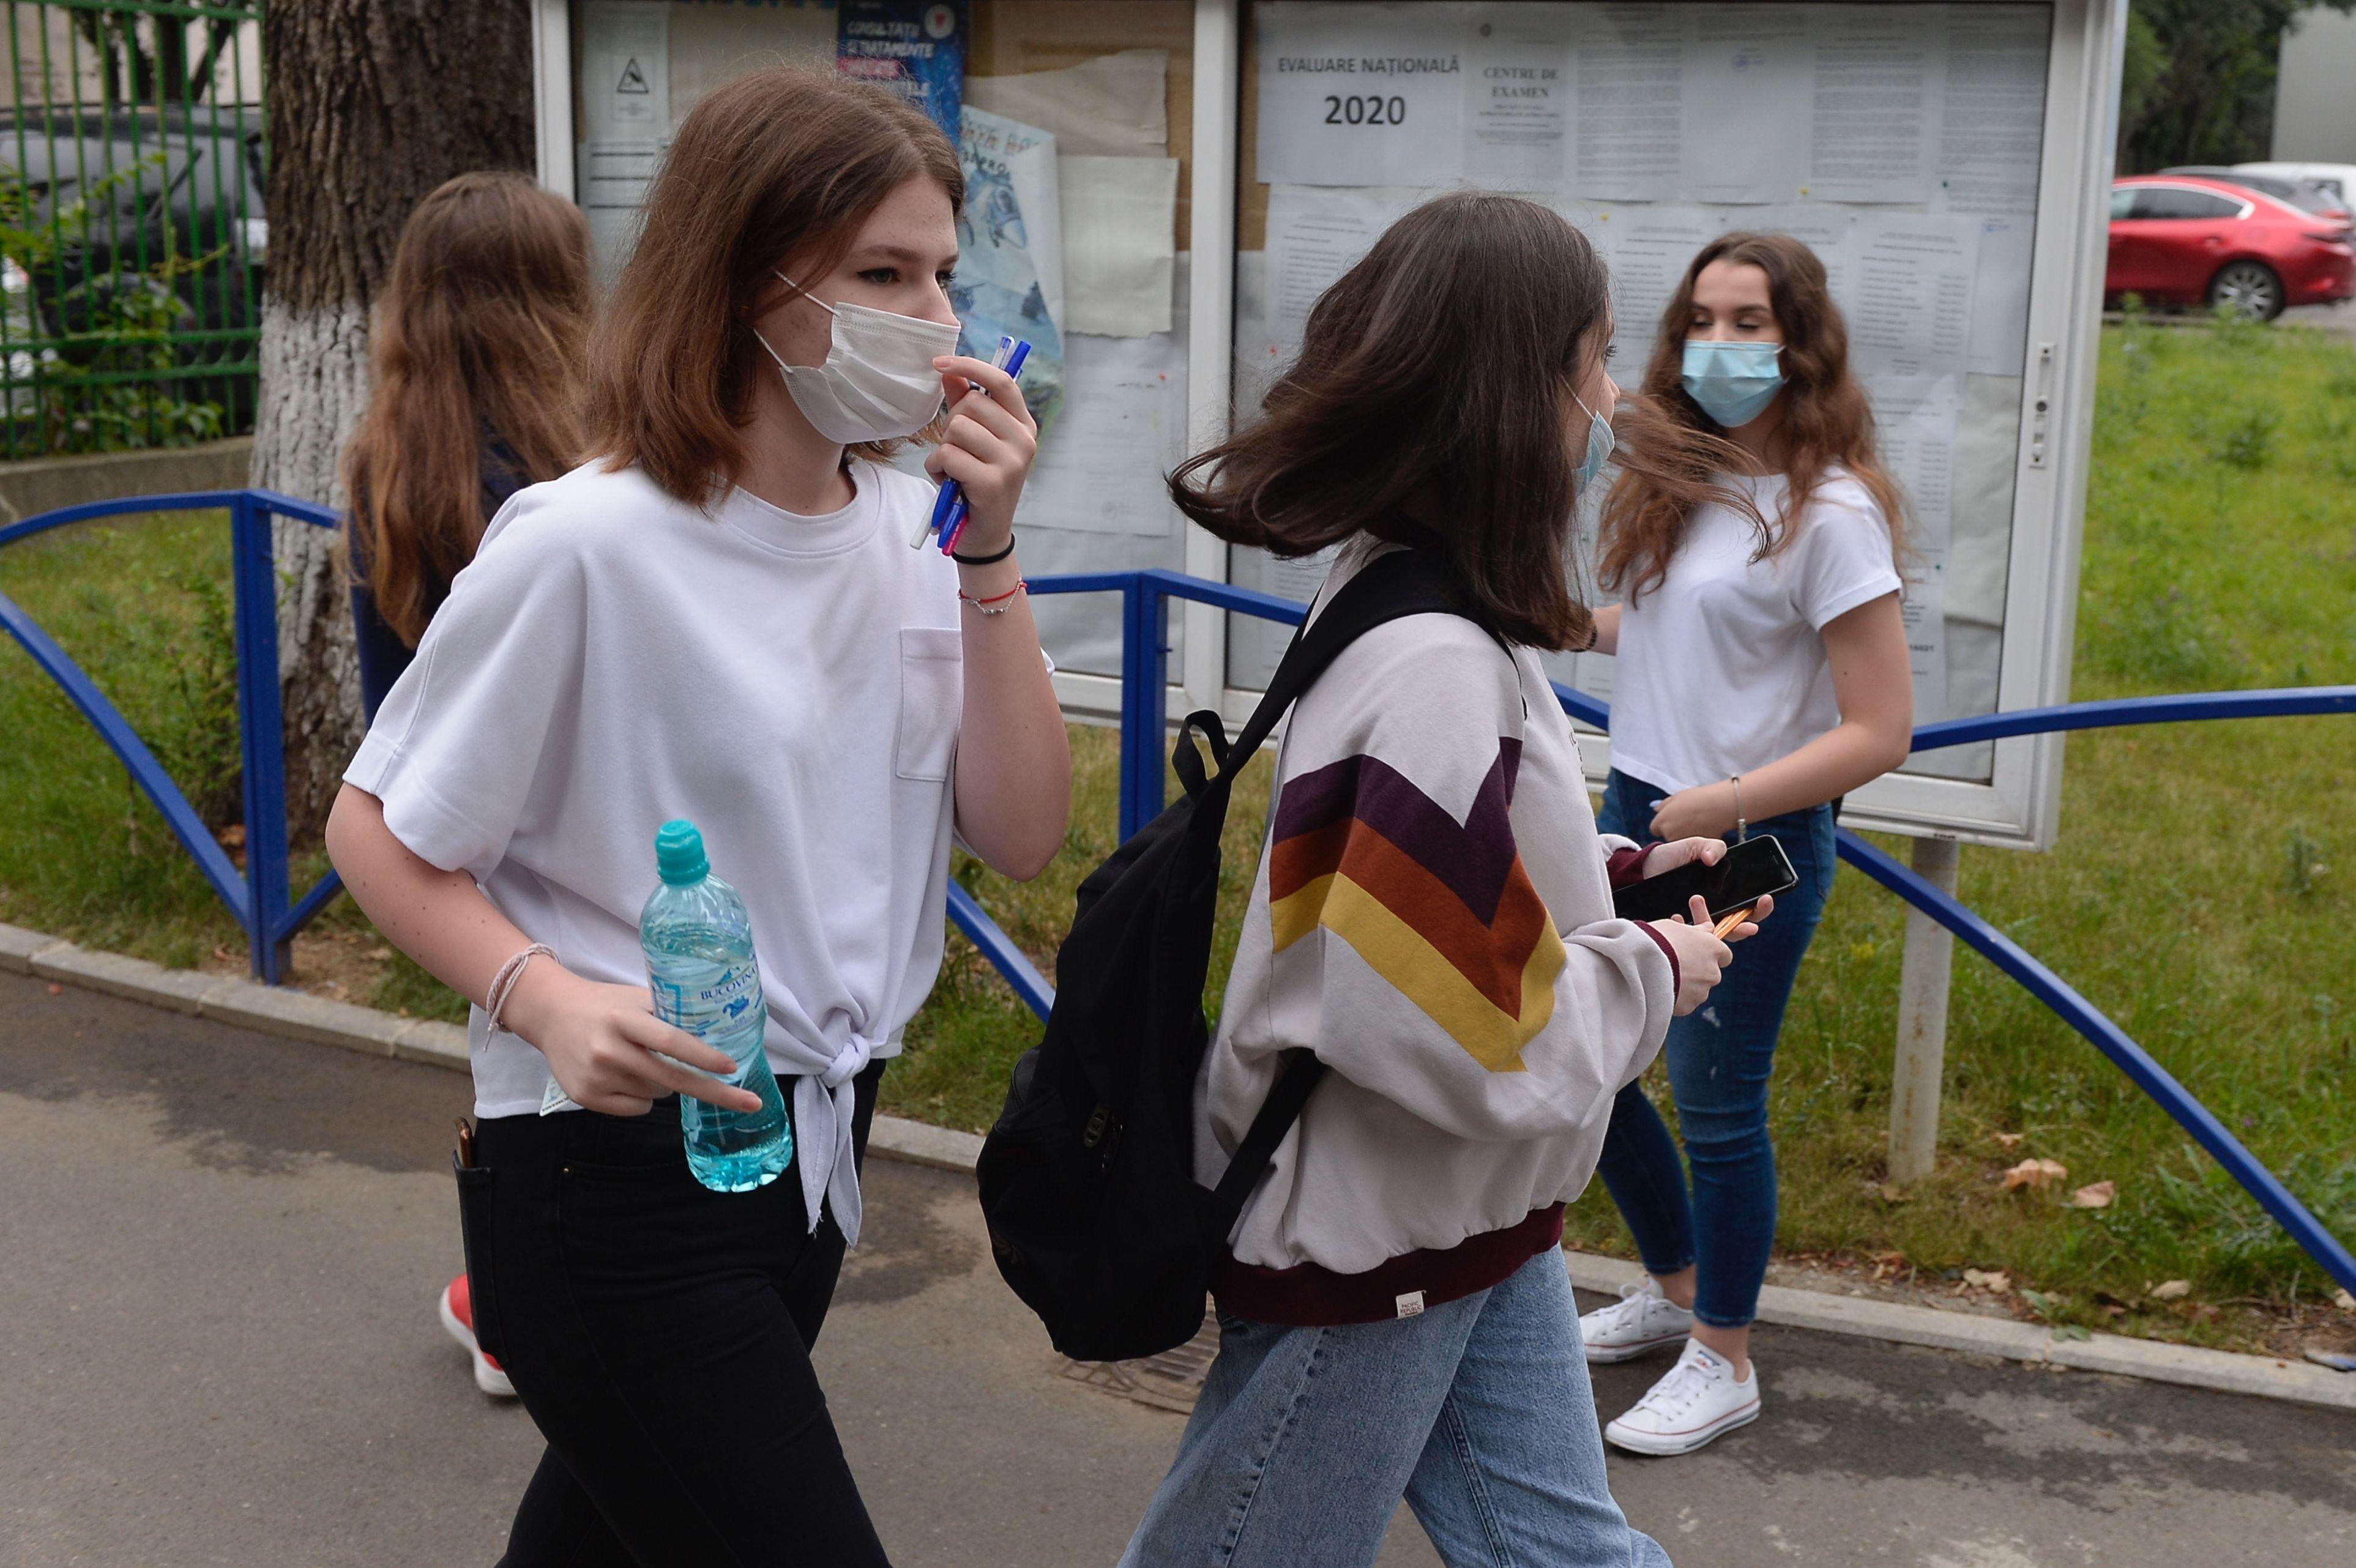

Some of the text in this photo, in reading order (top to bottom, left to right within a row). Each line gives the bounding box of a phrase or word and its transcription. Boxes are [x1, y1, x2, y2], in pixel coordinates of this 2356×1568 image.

[1278, 54, 1461, 77] EVALUARE NAȚIONALĂ
[1541, 68, 1559, 80] DE
[1491, 86, 1549, 98] EXAMEN
[1324, 95, 1406, 125] 2020
[699, 966, 756, 1000] BUCOVINA
[1400, 1304, 1422, 1313] REPUBLIC
